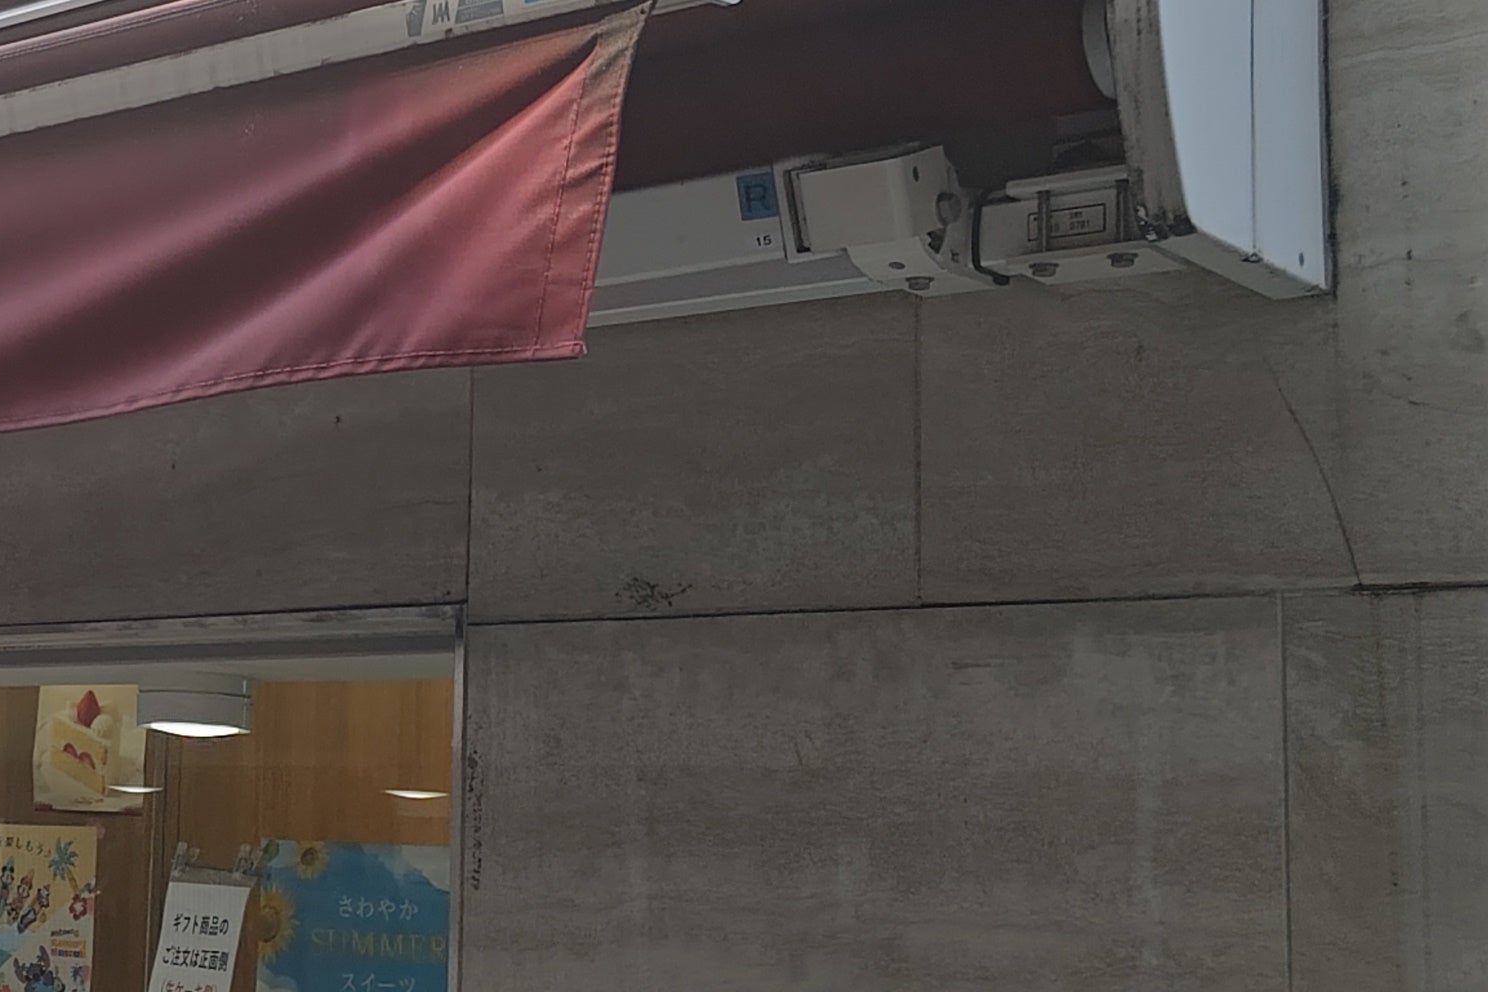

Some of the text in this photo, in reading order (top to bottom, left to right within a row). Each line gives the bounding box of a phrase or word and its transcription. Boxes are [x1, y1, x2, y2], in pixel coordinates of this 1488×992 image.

[744, 184, 772, 212] R
[338, 895, 419, 921] さわやか
[173, 912, 230, 936] ギフト商品の
[162, 945, 230, 972] ご注文は正面側
[341, 972, 416, 992] スイーツ
